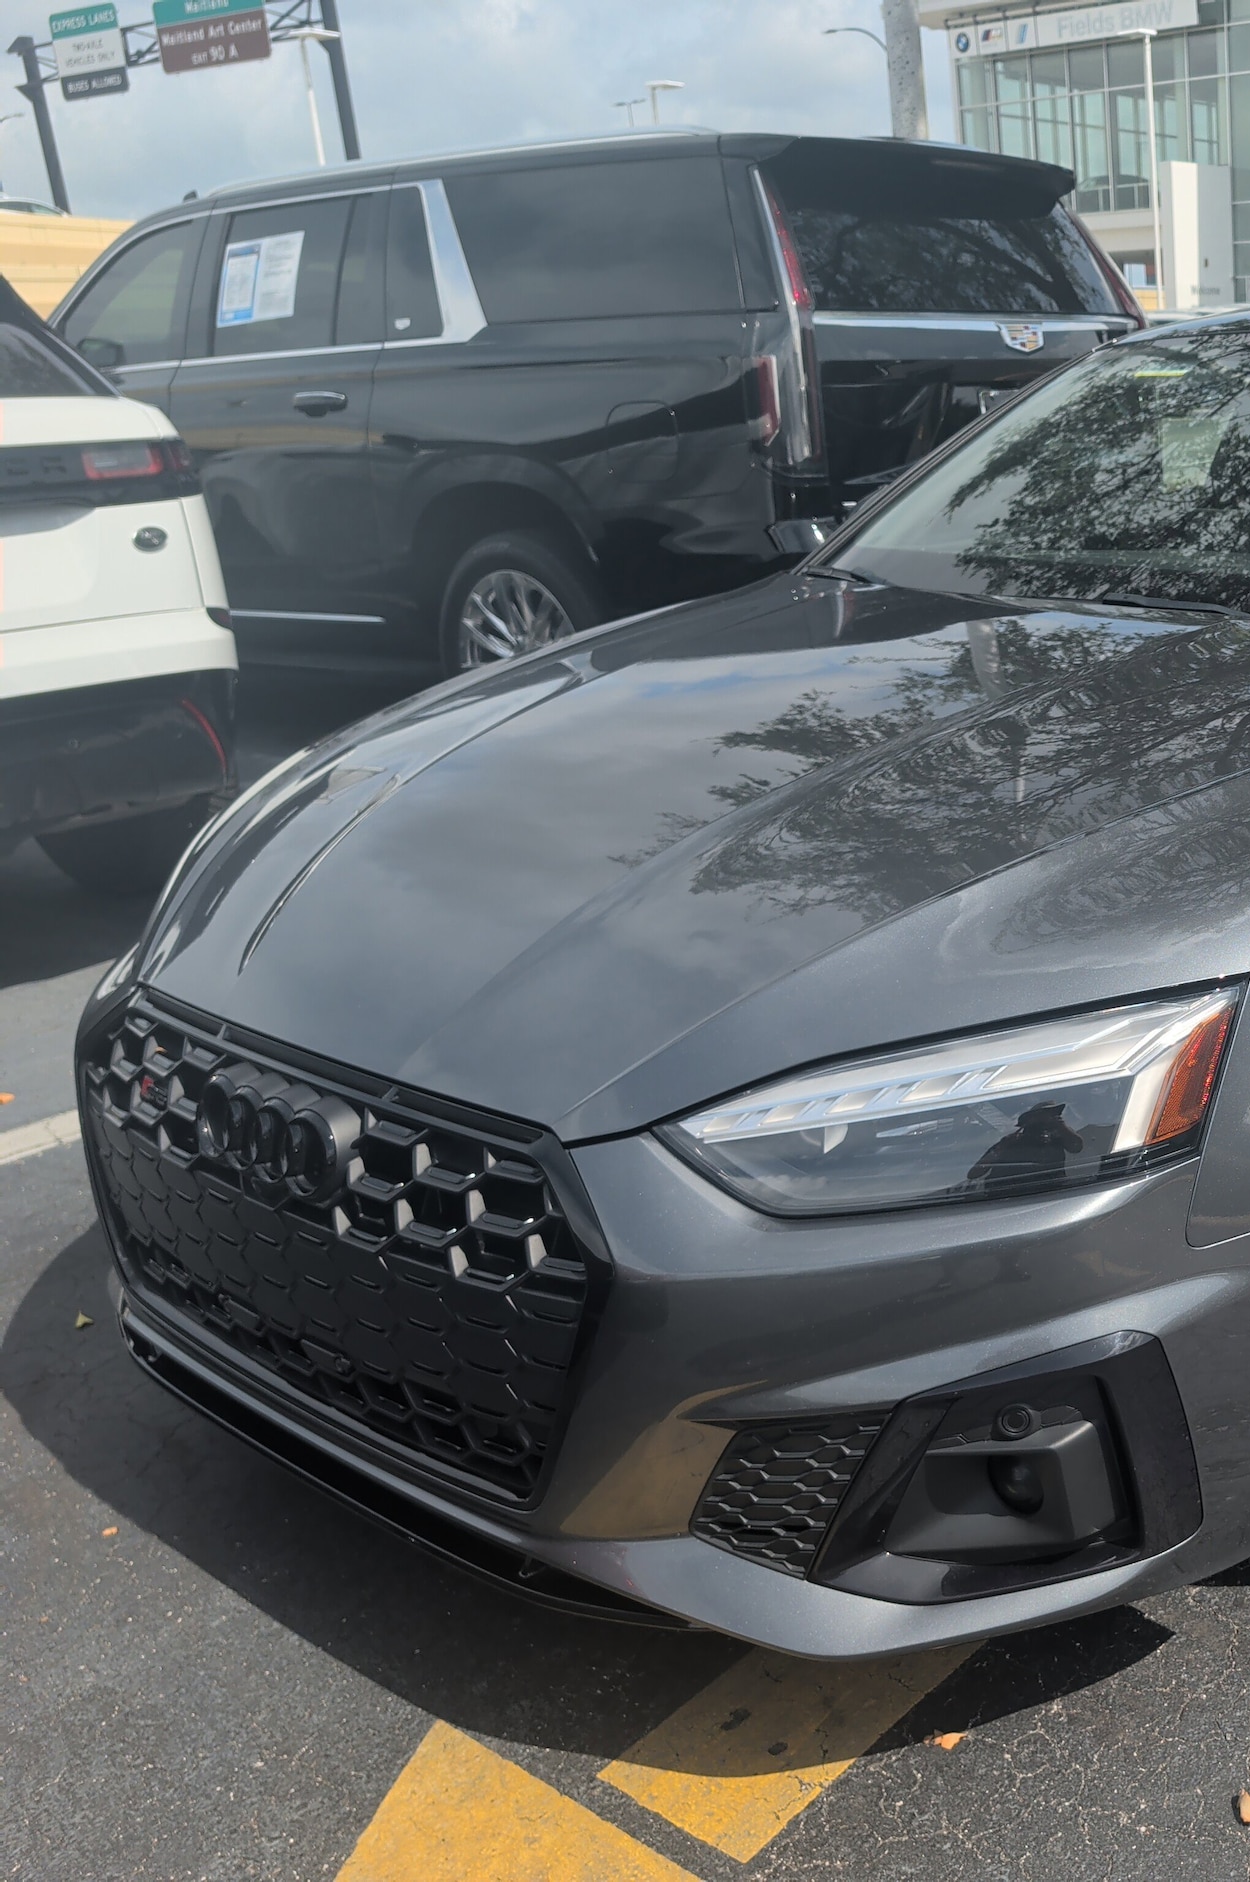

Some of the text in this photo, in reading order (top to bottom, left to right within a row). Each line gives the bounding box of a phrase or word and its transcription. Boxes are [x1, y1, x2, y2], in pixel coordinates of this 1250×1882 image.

[184, 0, 229, 14] Maitland
[52, 9, 116, 33] EXPRESS LANES
[1056, 11, 1115, 38] Fields
[1121, 0, 1174, 29] BMW
[161, 19, 262, 46] Maitland Art Center
[208, 44, 225, 61] 90
[228, 42, 240, 59] A
[67, 73, 122, 94] BUSES ALLOWED
